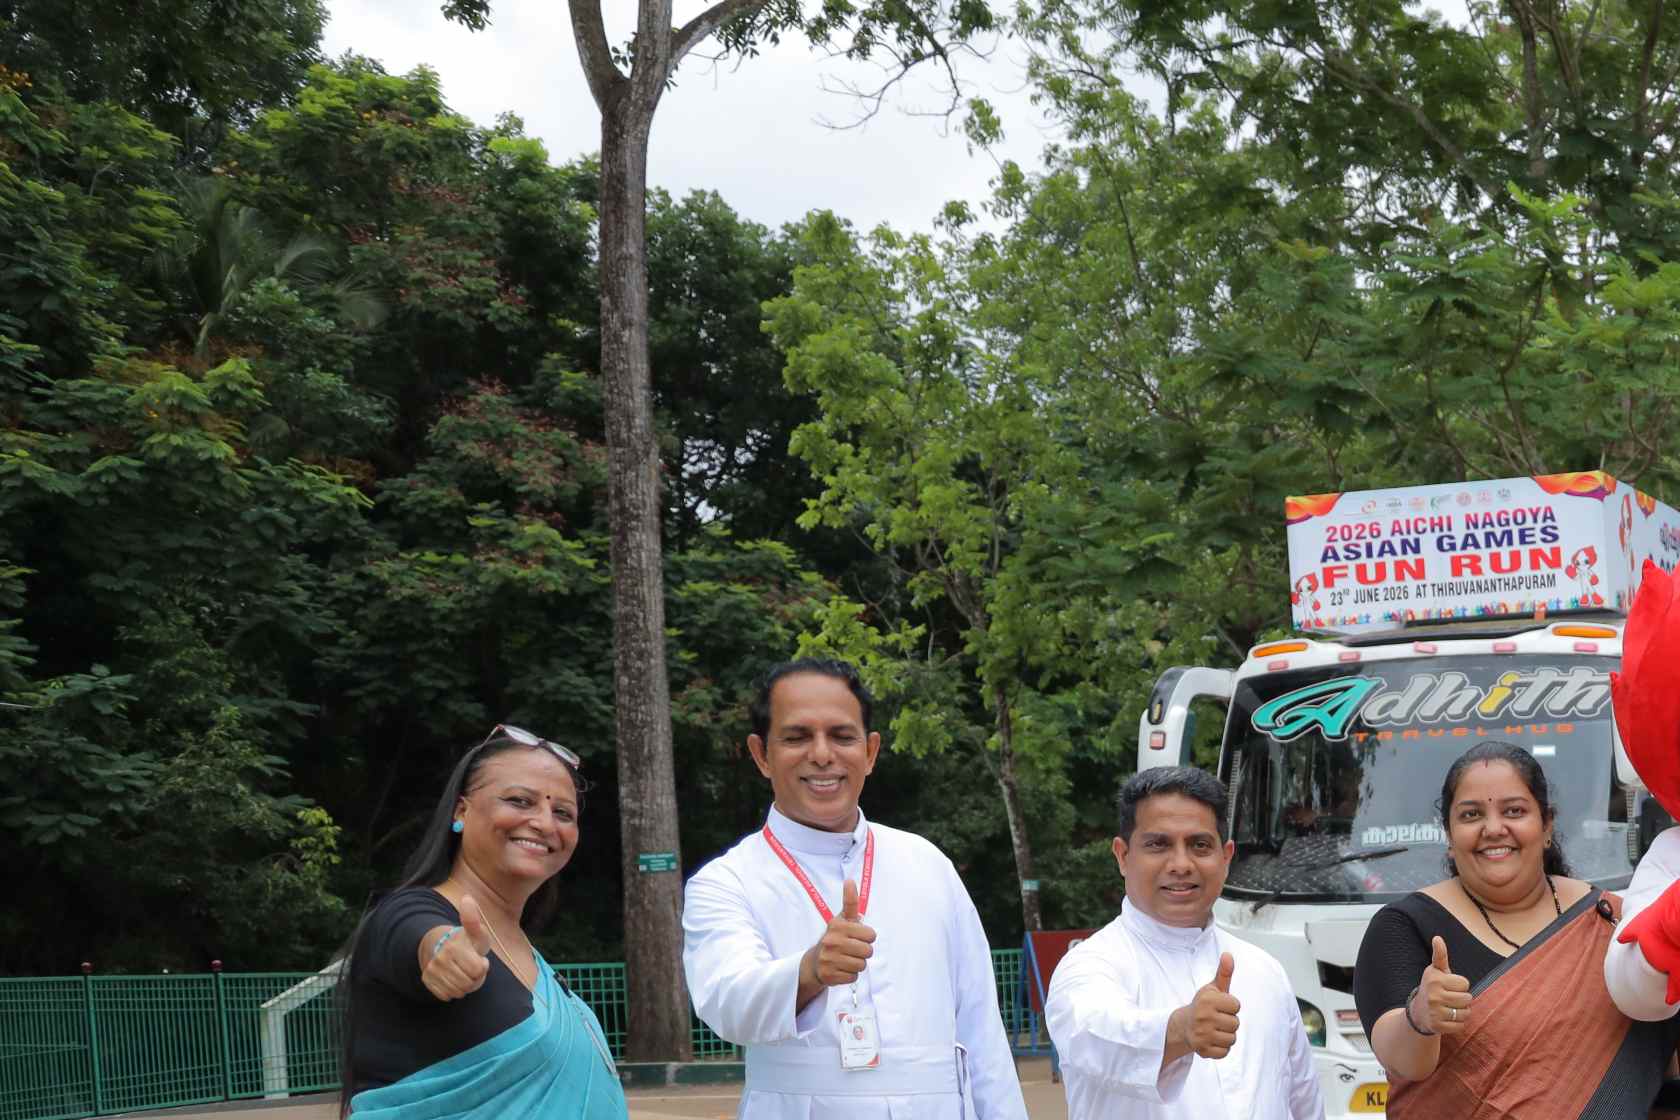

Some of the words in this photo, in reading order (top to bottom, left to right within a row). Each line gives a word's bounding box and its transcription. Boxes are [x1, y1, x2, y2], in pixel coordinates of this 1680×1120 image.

[1326, 521, 1381, 543] 2026
[1391, 515, 1453, 536] AICHI
[1464, 505, 1556, 530] NAGOYA
[1320, 537, 1421, 563] ASIAN
[1436, 525, 1560, 552] GAMES
[1322, 557, 1426, 588] FUN
[1449, 546, 1562, 577] RUN
[1353, 586, 1380, 604] JUNE
[1383, 585, 1409, 601] 2026
[1415, 583, 1428, 599] AT
[1431, 573, 1557, 598] THIRUVANANTHAPURAM
